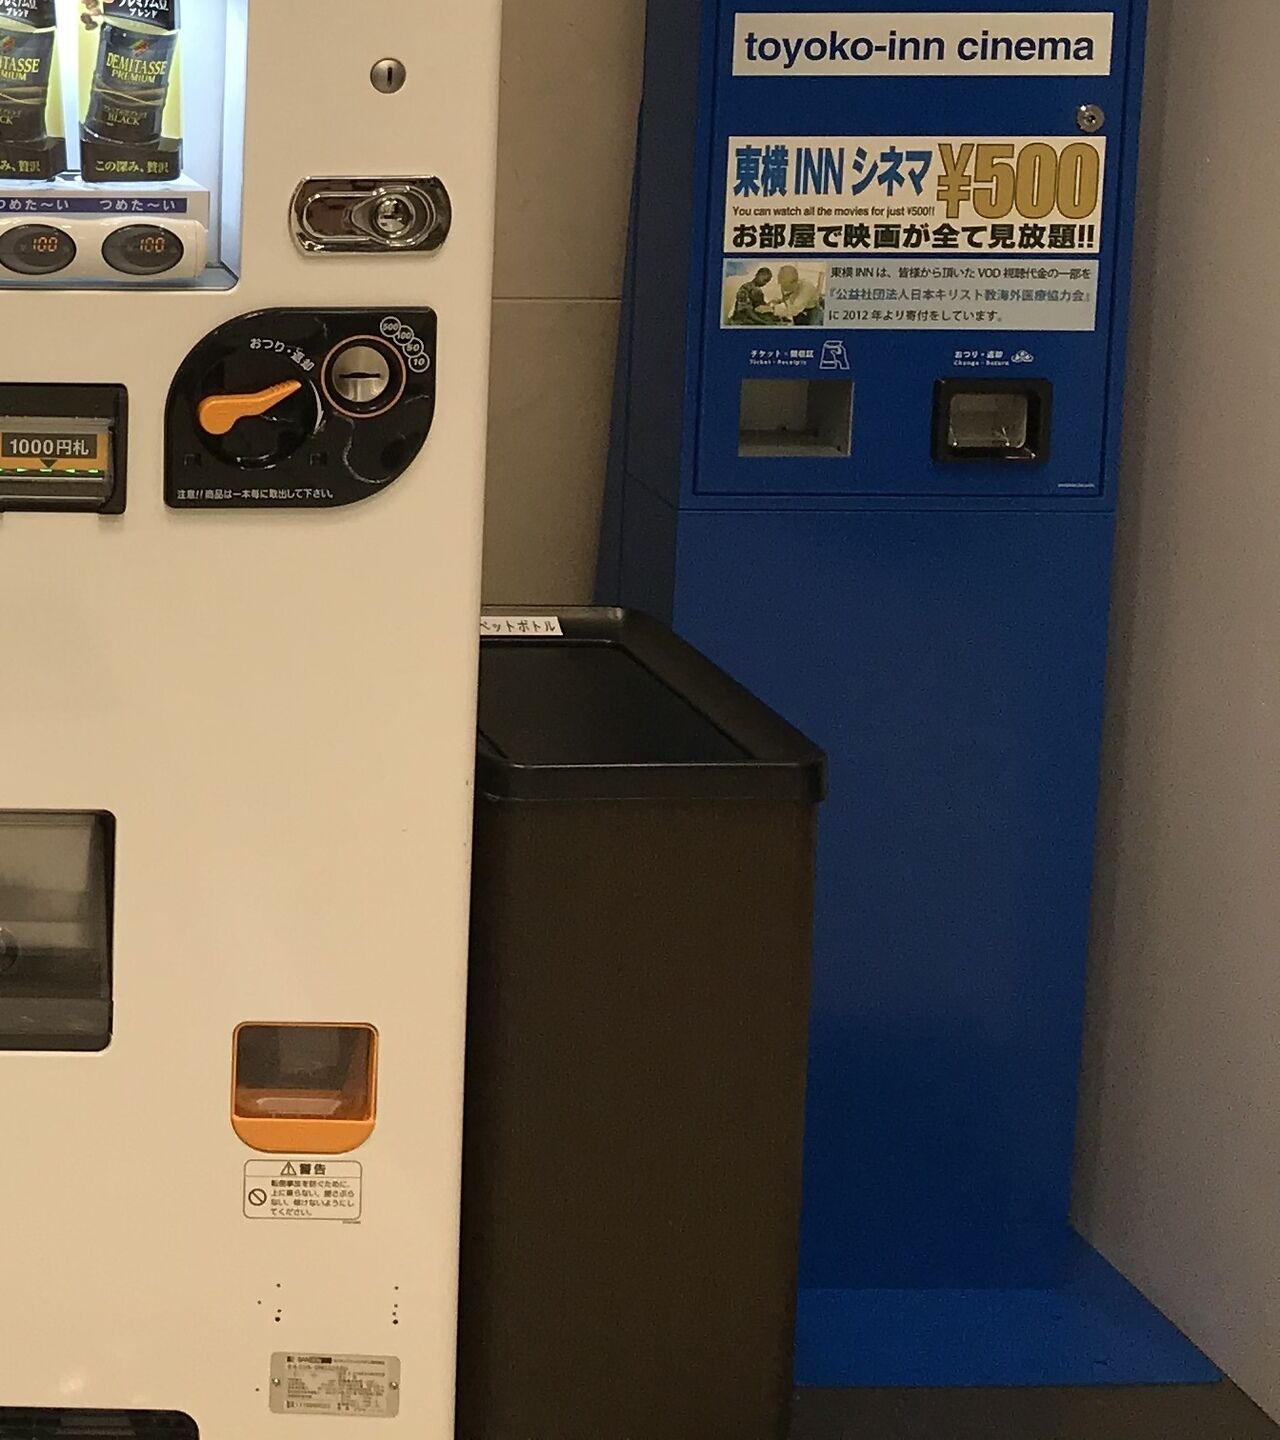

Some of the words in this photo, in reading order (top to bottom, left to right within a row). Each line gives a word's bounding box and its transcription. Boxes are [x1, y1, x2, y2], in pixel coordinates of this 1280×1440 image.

[744, 30, 945, 69] toyoko-inn
[957, 30, 1094, 62] cinema
[106, 51, 167, 75] DEMITASSE
[111, 68, 156, 84] PREMIUM
[107, 113, 141, 126] BLACK
[937, 141, 1100, 220] ¥500
[732, 206, 751, 216] You
[753, 208, 771, 216] can
[773, 206, 801, 216] watch
[803, 206, 815, 216] all
[817, 206, 832, 216] the
[834, 206, 868, 216] movies
[870, 206, 885, 216] for
[886, 206, 905, 218] just
[139, 235, 167, 252] 100
[732, 222, 1095, 249] お部屋で映画が全て見放題!!
[249, 337, 315, 372] おつり・返却
[8, 437, 90, 457] 1000円札
[299, 1163, 327, 1176] 警告
